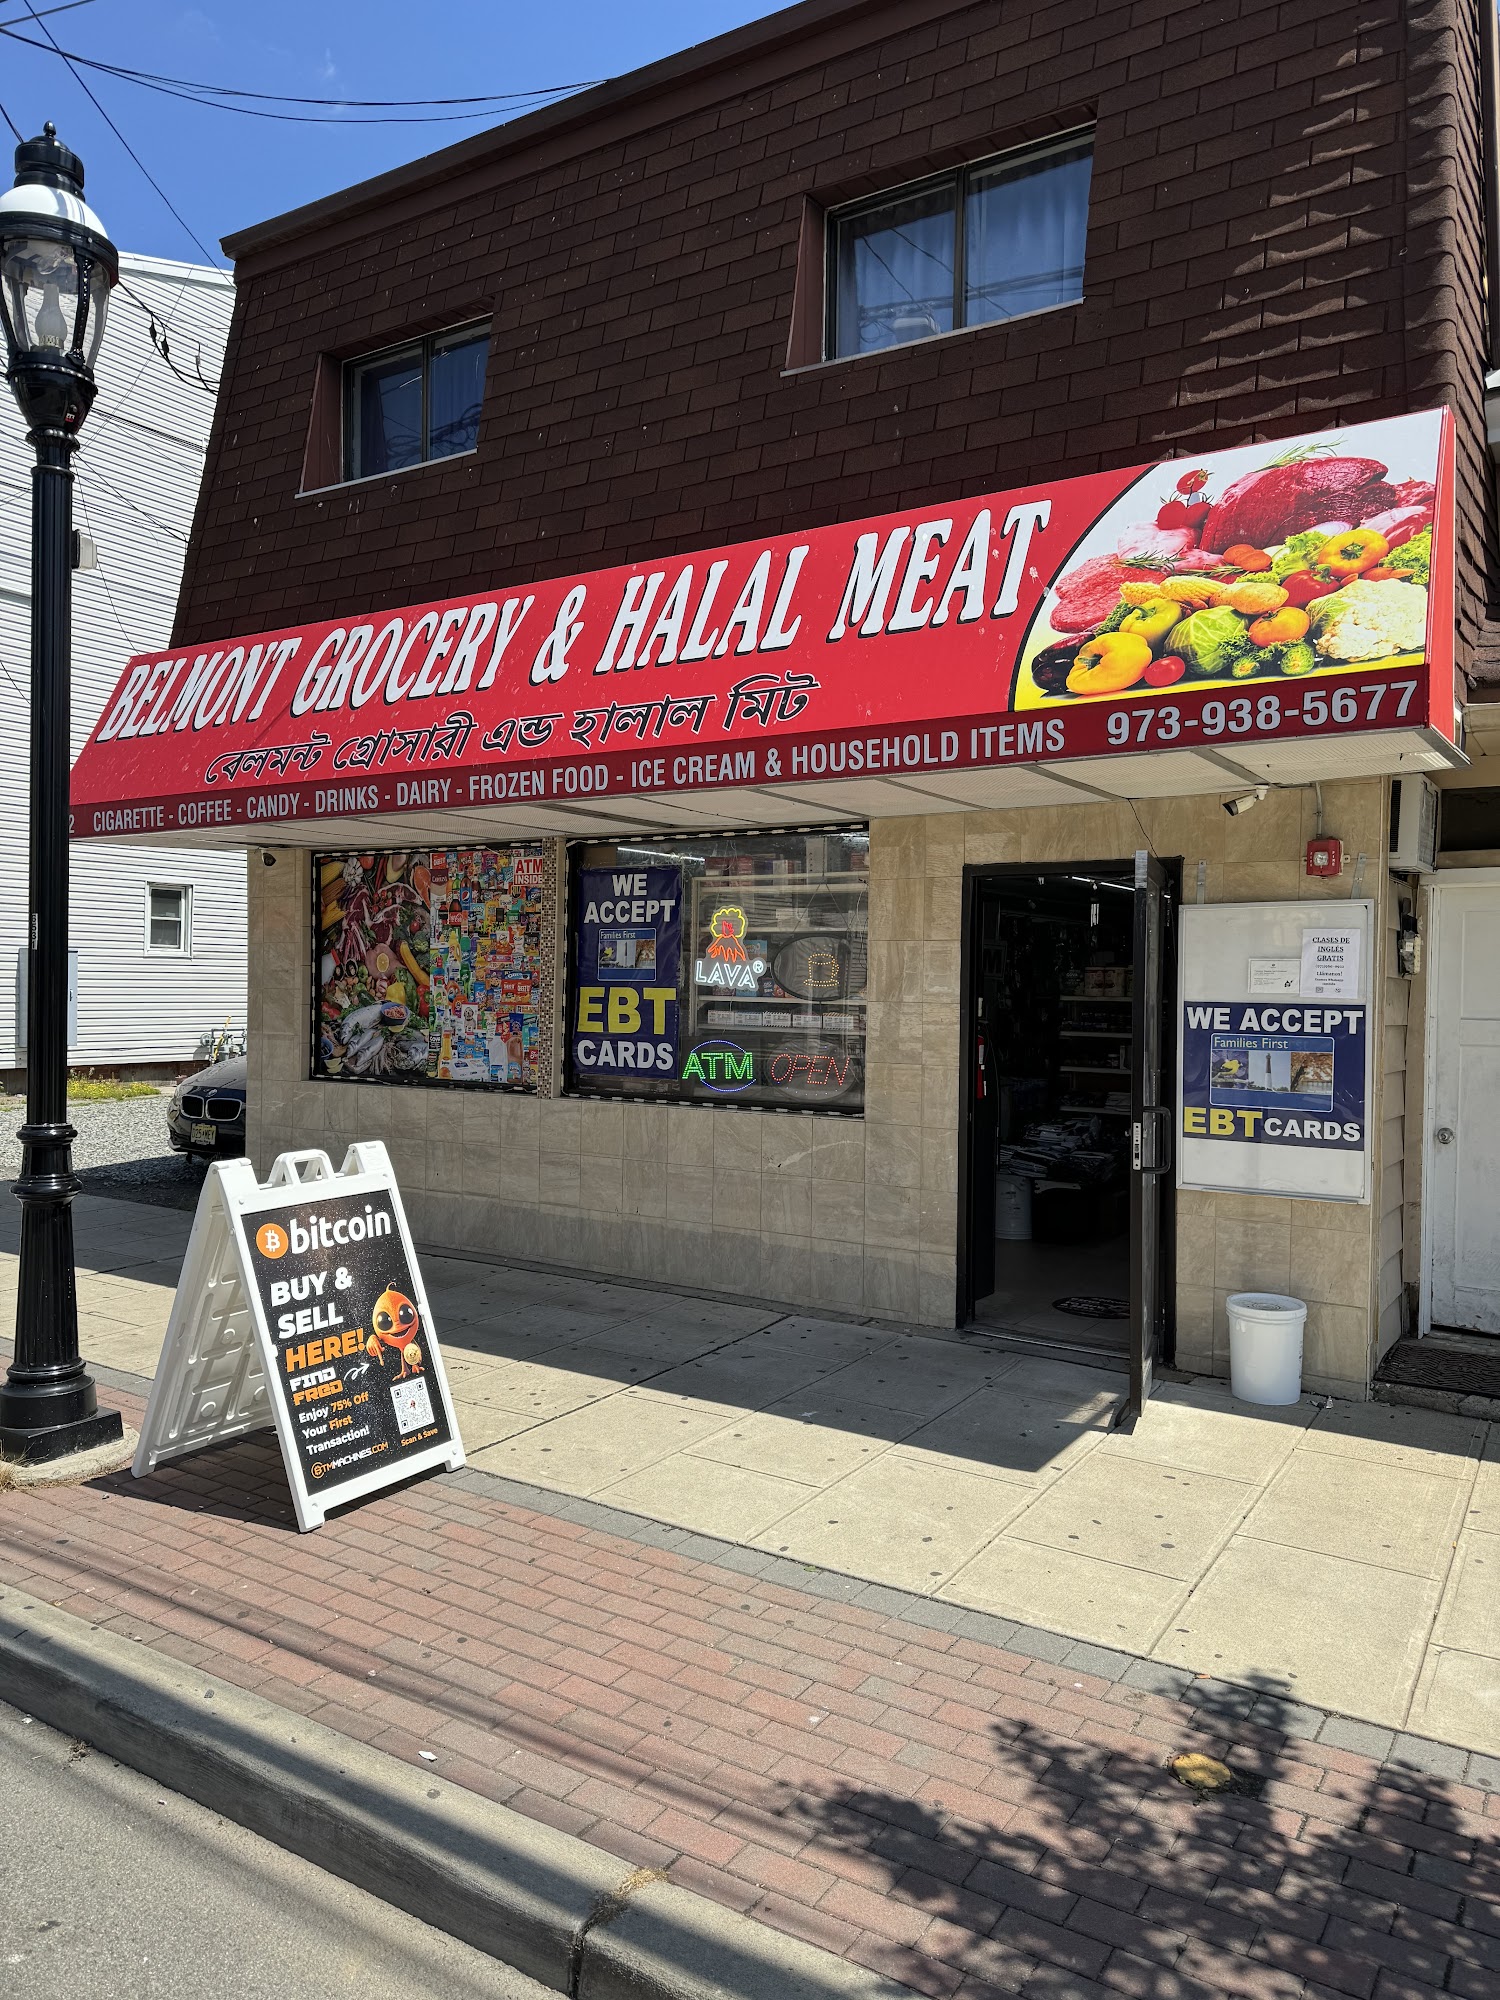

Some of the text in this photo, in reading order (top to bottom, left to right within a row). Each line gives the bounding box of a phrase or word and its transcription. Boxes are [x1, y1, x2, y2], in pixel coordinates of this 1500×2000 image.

[95, 499, 1052, 744] BELMONT GROCERY & HALAL MEAT
[569, 694, 717, 749] হালাল
[723, 670, 821, 731] মিট
[1106, 680, 1418, 746] 973-938-5677
[93, 805, 165, 832] CIGARETTE
[178, 799, 232, 826] COFFEE
[247, 792, 301, 820] CANDY
[315, 784, 379, 814] DRINKS
[396, 777, 452, 807] DAIRY
[469, 770, 545, 800] FROZEN
[552, 764, 609, 794] FOOD
[631, 758, 666, 788] ICE
[673, 751, 755, 785] CREAM
[764, 748, 782, 777] &
[792, 731, 959, 775] HOUSEHOLD
[970, 718, 1065, 759] ITEMS
[514, 874, 542, 885] INSIDE
[515, 858, 542, 874] ATM
[612, 873, 648, 897] WE
[583, 899, 675, 924] ACCEPT
[623, 930, 636, 939] First
[576, 986, 677, 1035] EBT
[1186, 1006, 1364, 1035] WE ACCEPT
[576, 1039, 674, 1071] CARDS
[1214, 1036, 1289, 1049] Families First
[681, 1051, 753, 1080] ATM
[770, 1053, 851, 1087] OPEN
[1183, 1106, 1361, 1142] EBT CARDS
[289, 1205, 391, 1255] bitcoin
[270, 1266, 352, 1307] BUY &
[278, 1301, 344, 1339] SELL
[286, 1328, 366, 1373] HERE!
[289, 1366, 337, 1392] FIND
[299, 1391, 369, 1424] Enjoy 75% Off
[302, 1415, 353, 1439] Your First
[306, 1425, 370, 1456] Transaction!
[401, 1435, 417, 1447] Scan
[422, 1427, 438, 1439] Save
